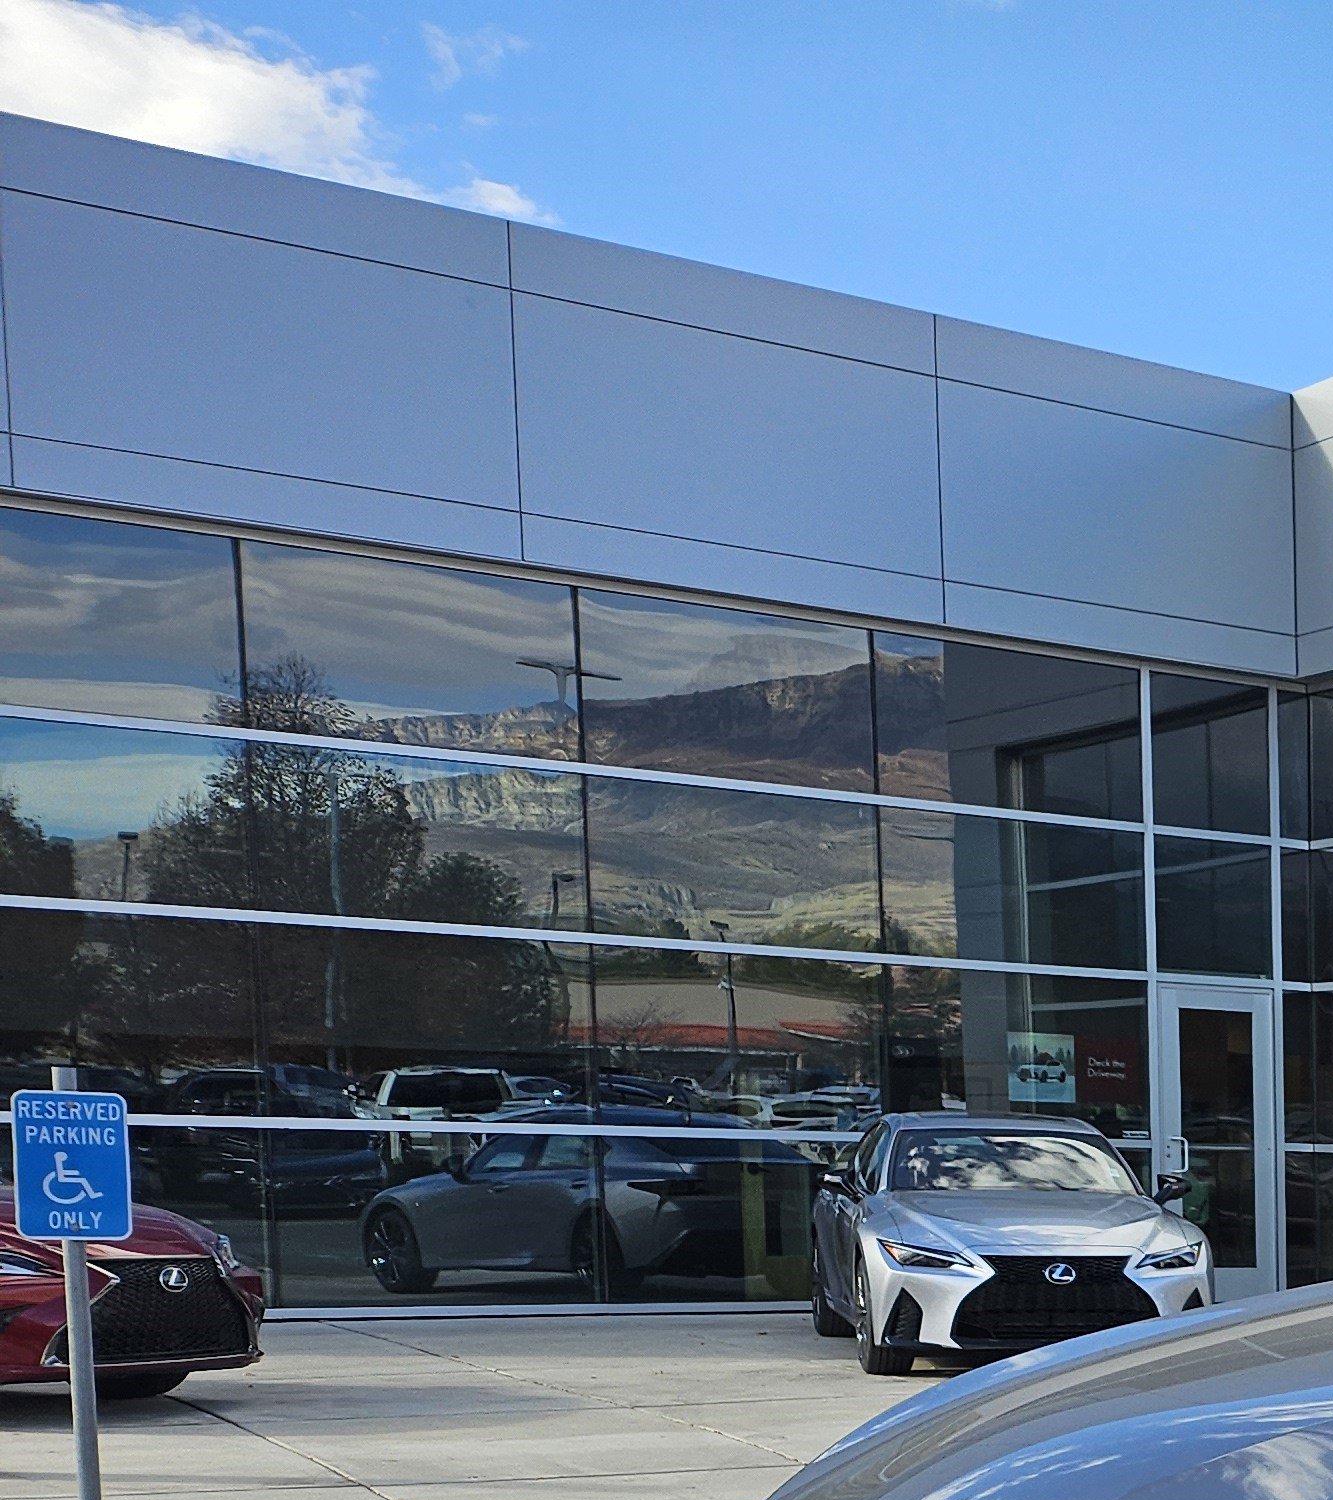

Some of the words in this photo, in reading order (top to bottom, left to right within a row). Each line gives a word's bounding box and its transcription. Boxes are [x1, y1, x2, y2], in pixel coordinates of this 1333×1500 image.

[18, 1101, 121, 1121] RESERVED
[25, 1126, 116, 1146] PARKING
[49, 1211, 103, 1230] ONLY
